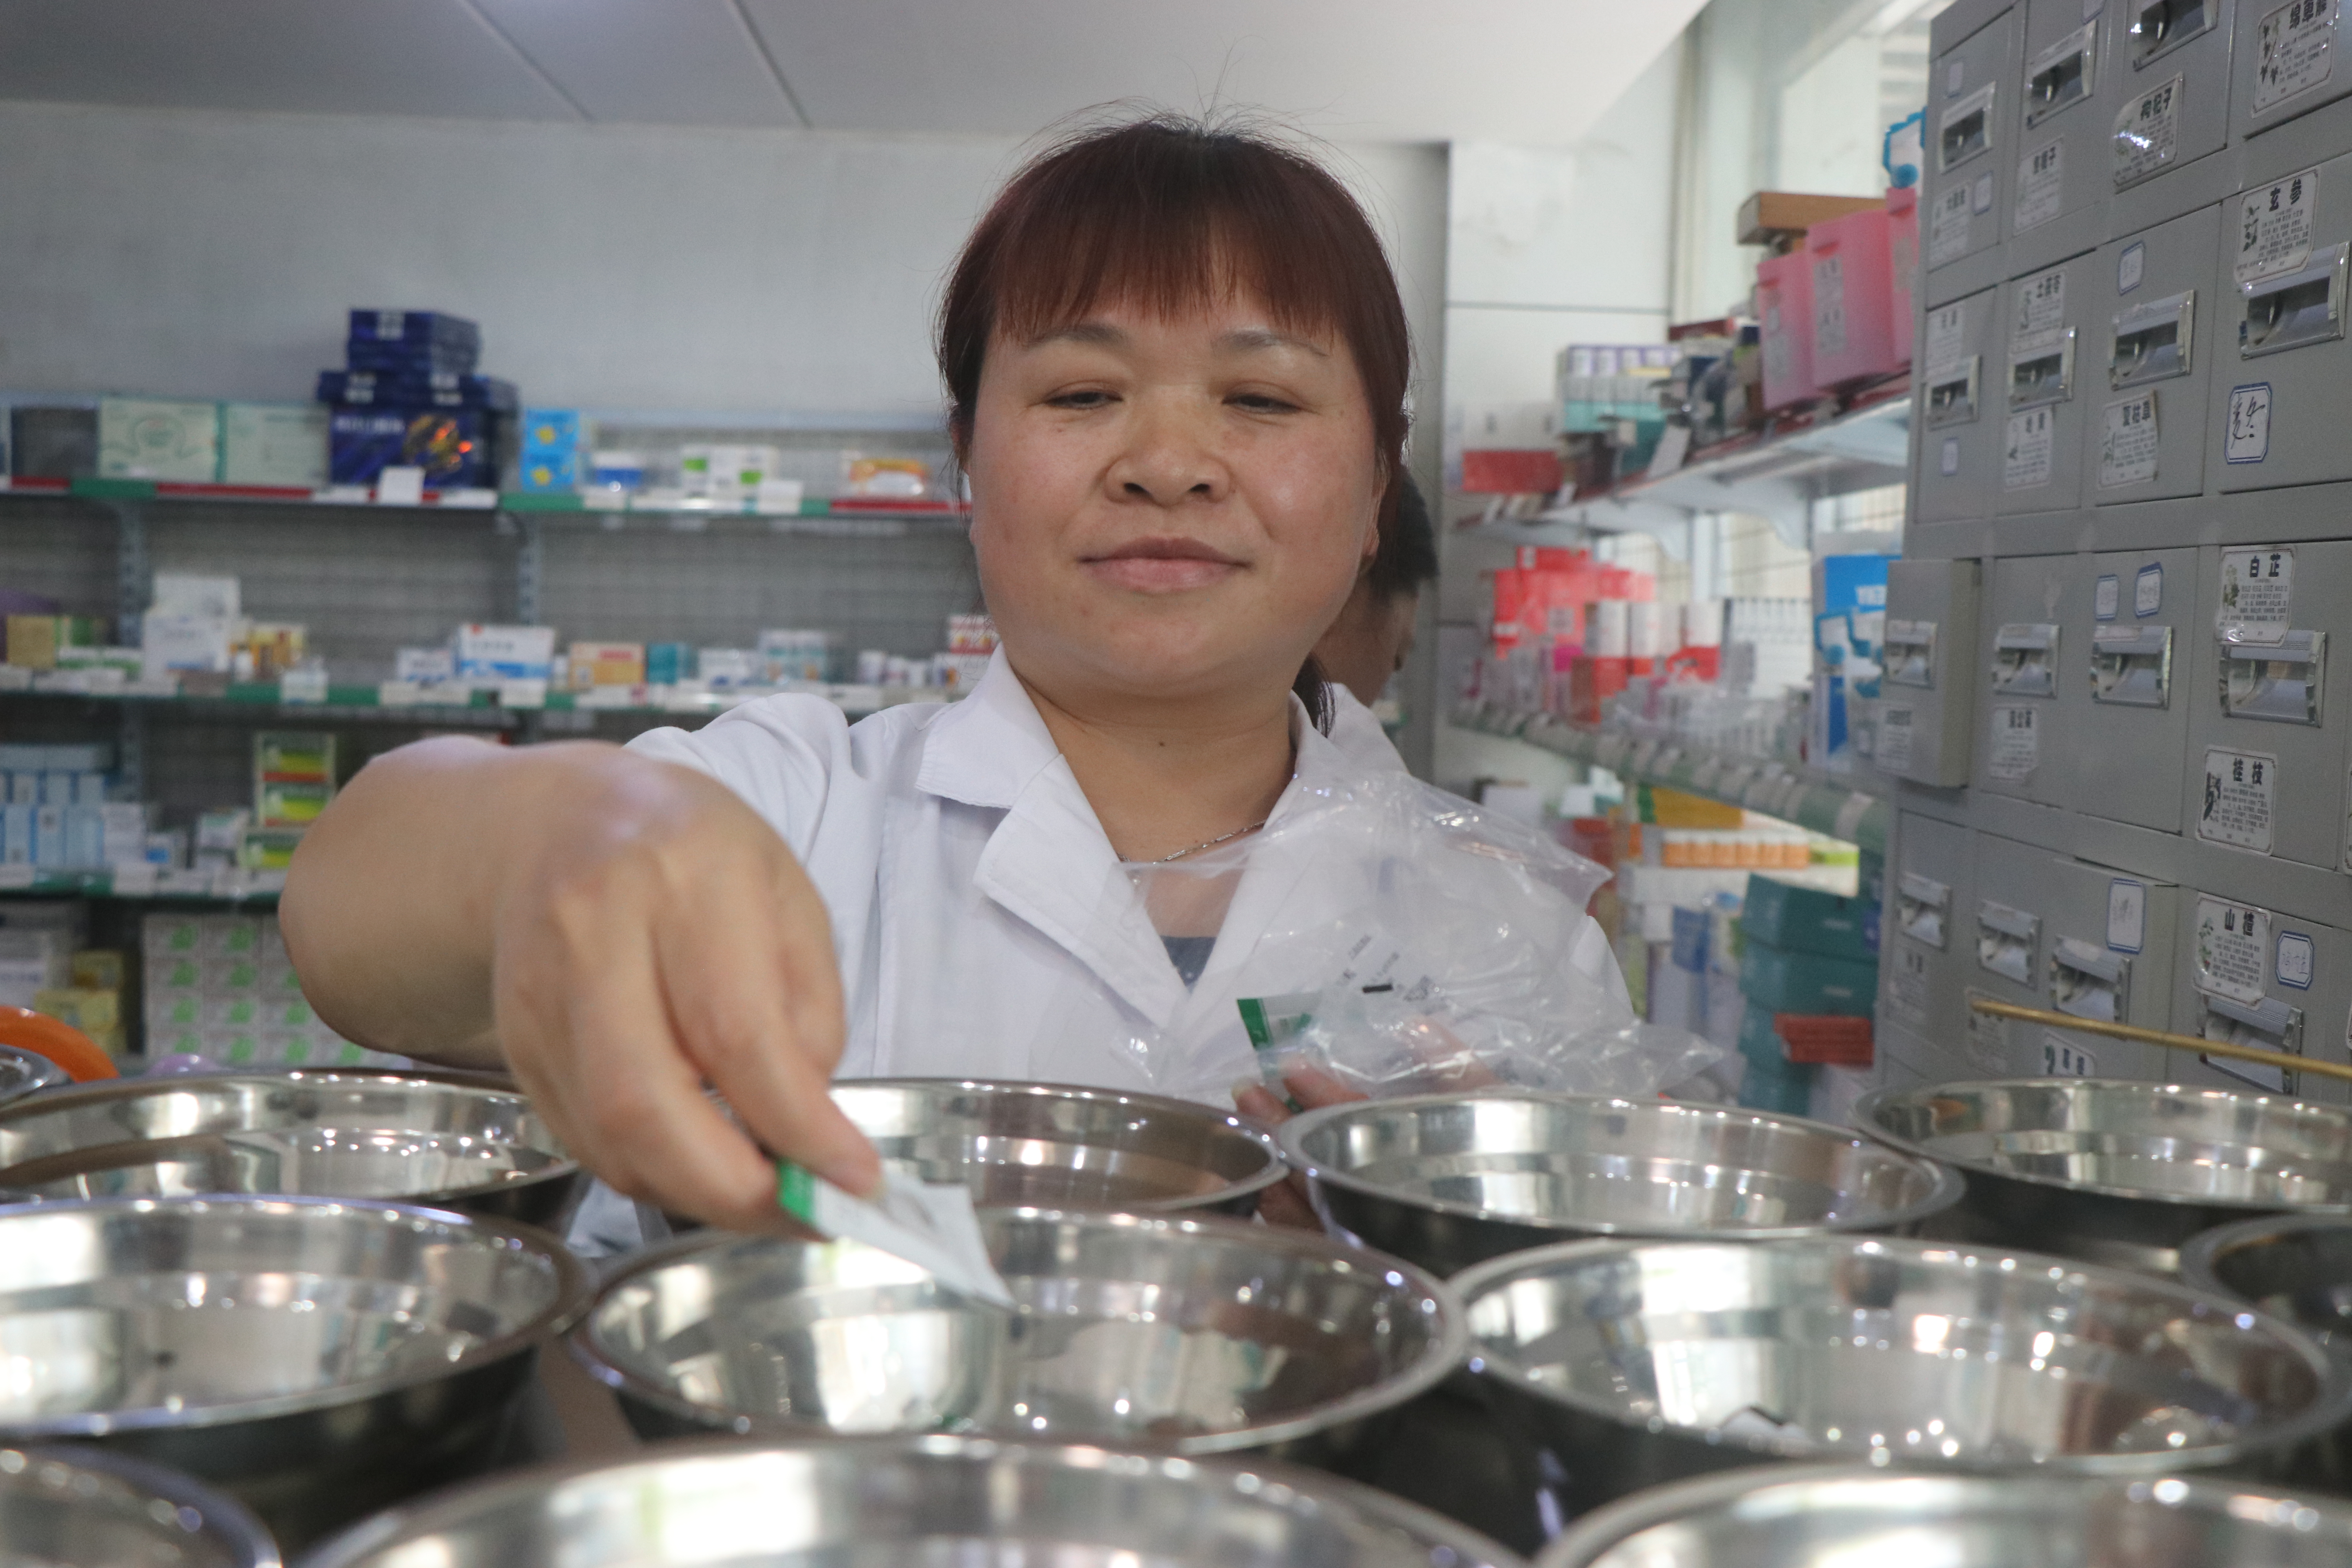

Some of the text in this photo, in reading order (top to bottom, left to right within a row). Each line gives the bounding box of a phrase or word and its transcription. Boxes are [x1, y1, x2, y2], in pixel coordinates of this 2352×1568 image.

[2250, 553, 2281, 577] 白芷
[2233, 757, 2263, 785] 桂枝
[2225, 908, 2254, 936] 山楂
